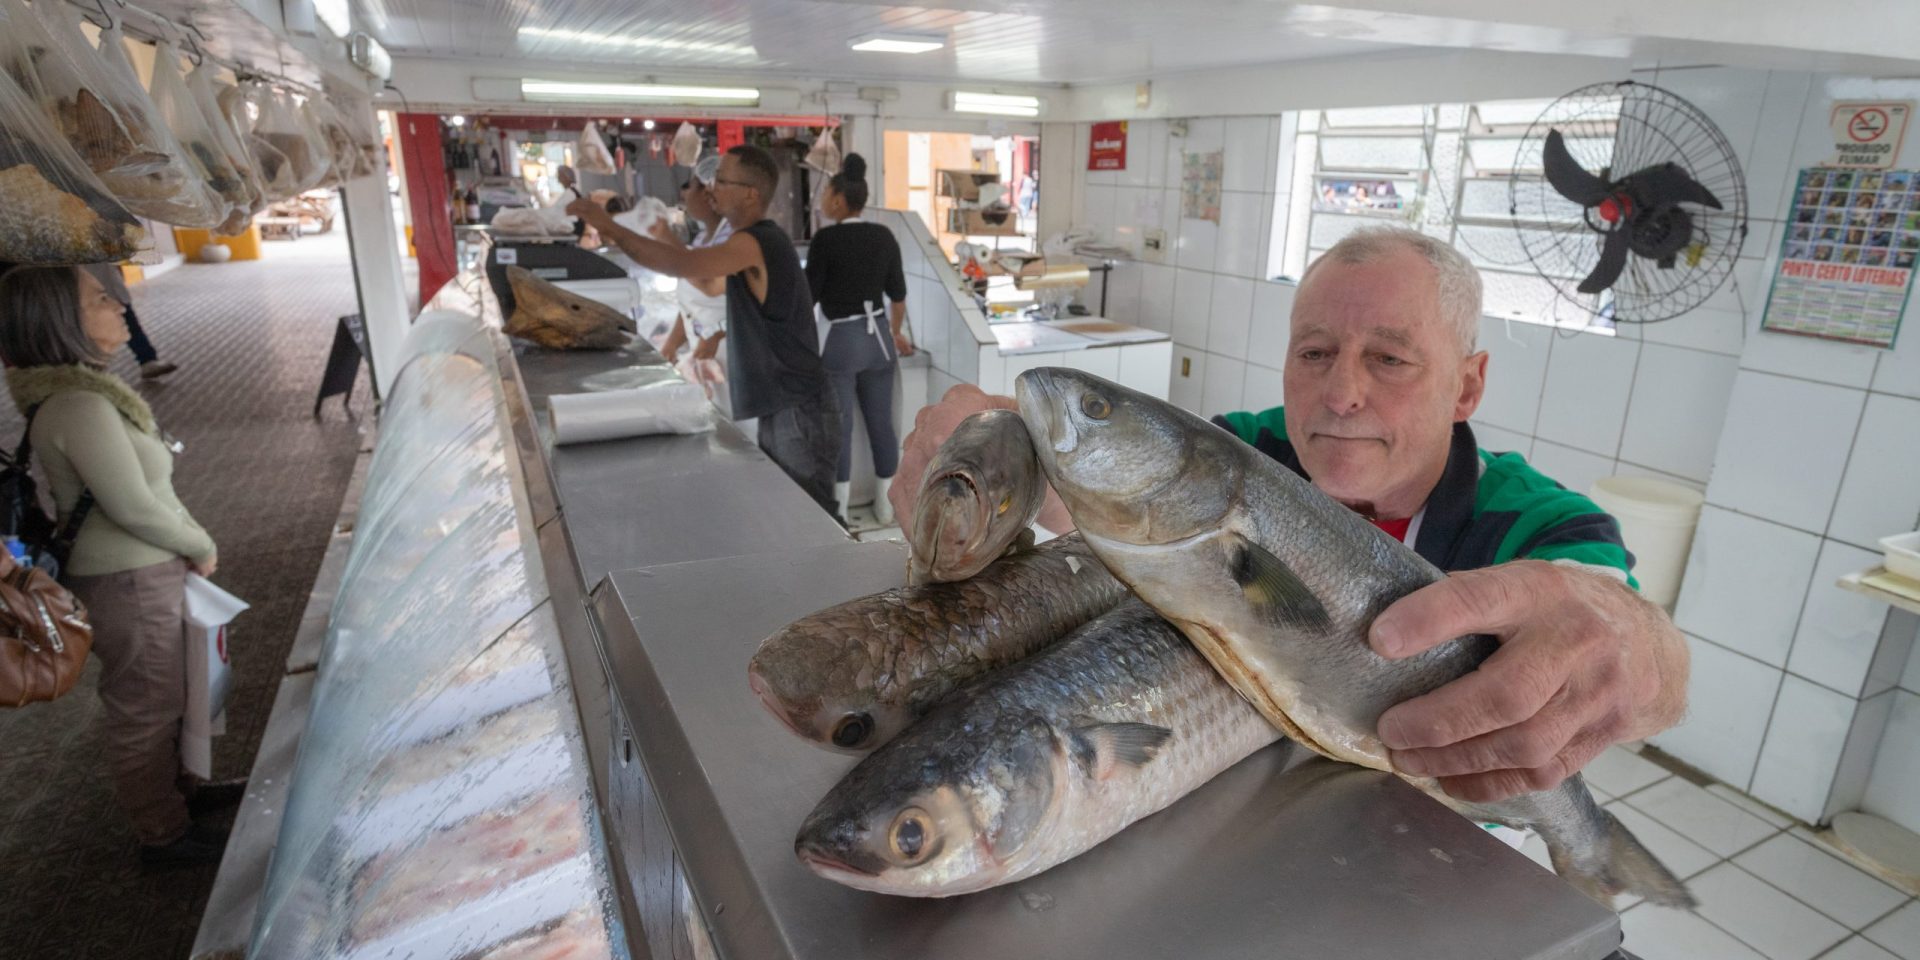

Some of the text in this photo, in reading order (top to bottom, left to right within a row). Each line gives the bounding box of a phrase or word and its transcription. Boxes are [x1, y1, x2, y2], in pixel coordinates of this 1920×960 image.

[1838, 155, 1879, 164] FUMAR
[1781, 260, 1907, 286] PONTO CERTO LOTERIAS
